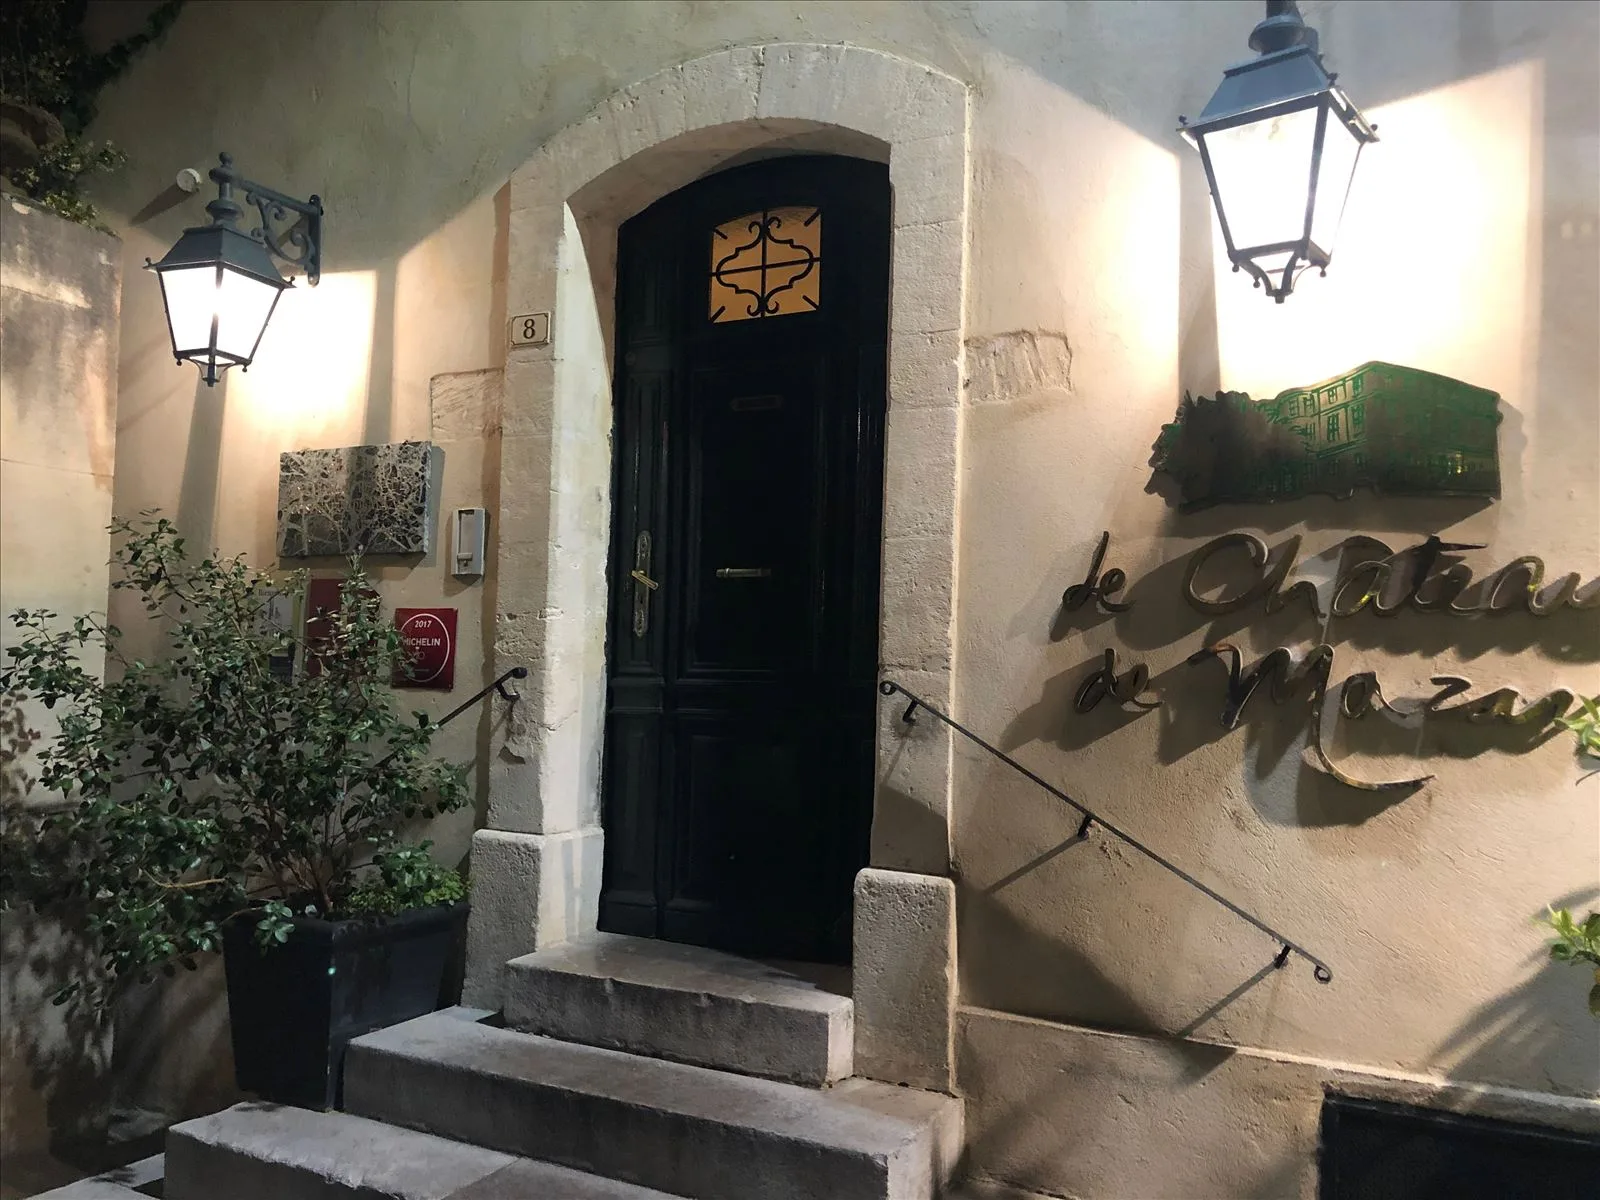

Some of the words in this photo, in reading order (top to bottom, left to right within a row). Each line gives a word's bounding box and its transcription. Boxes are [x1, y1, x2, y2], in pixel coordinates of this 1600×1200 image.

[522, 318, 536, 340] 8
[414, 619, 433, 628] 2017
[1073, 647, 1164, 715] de
